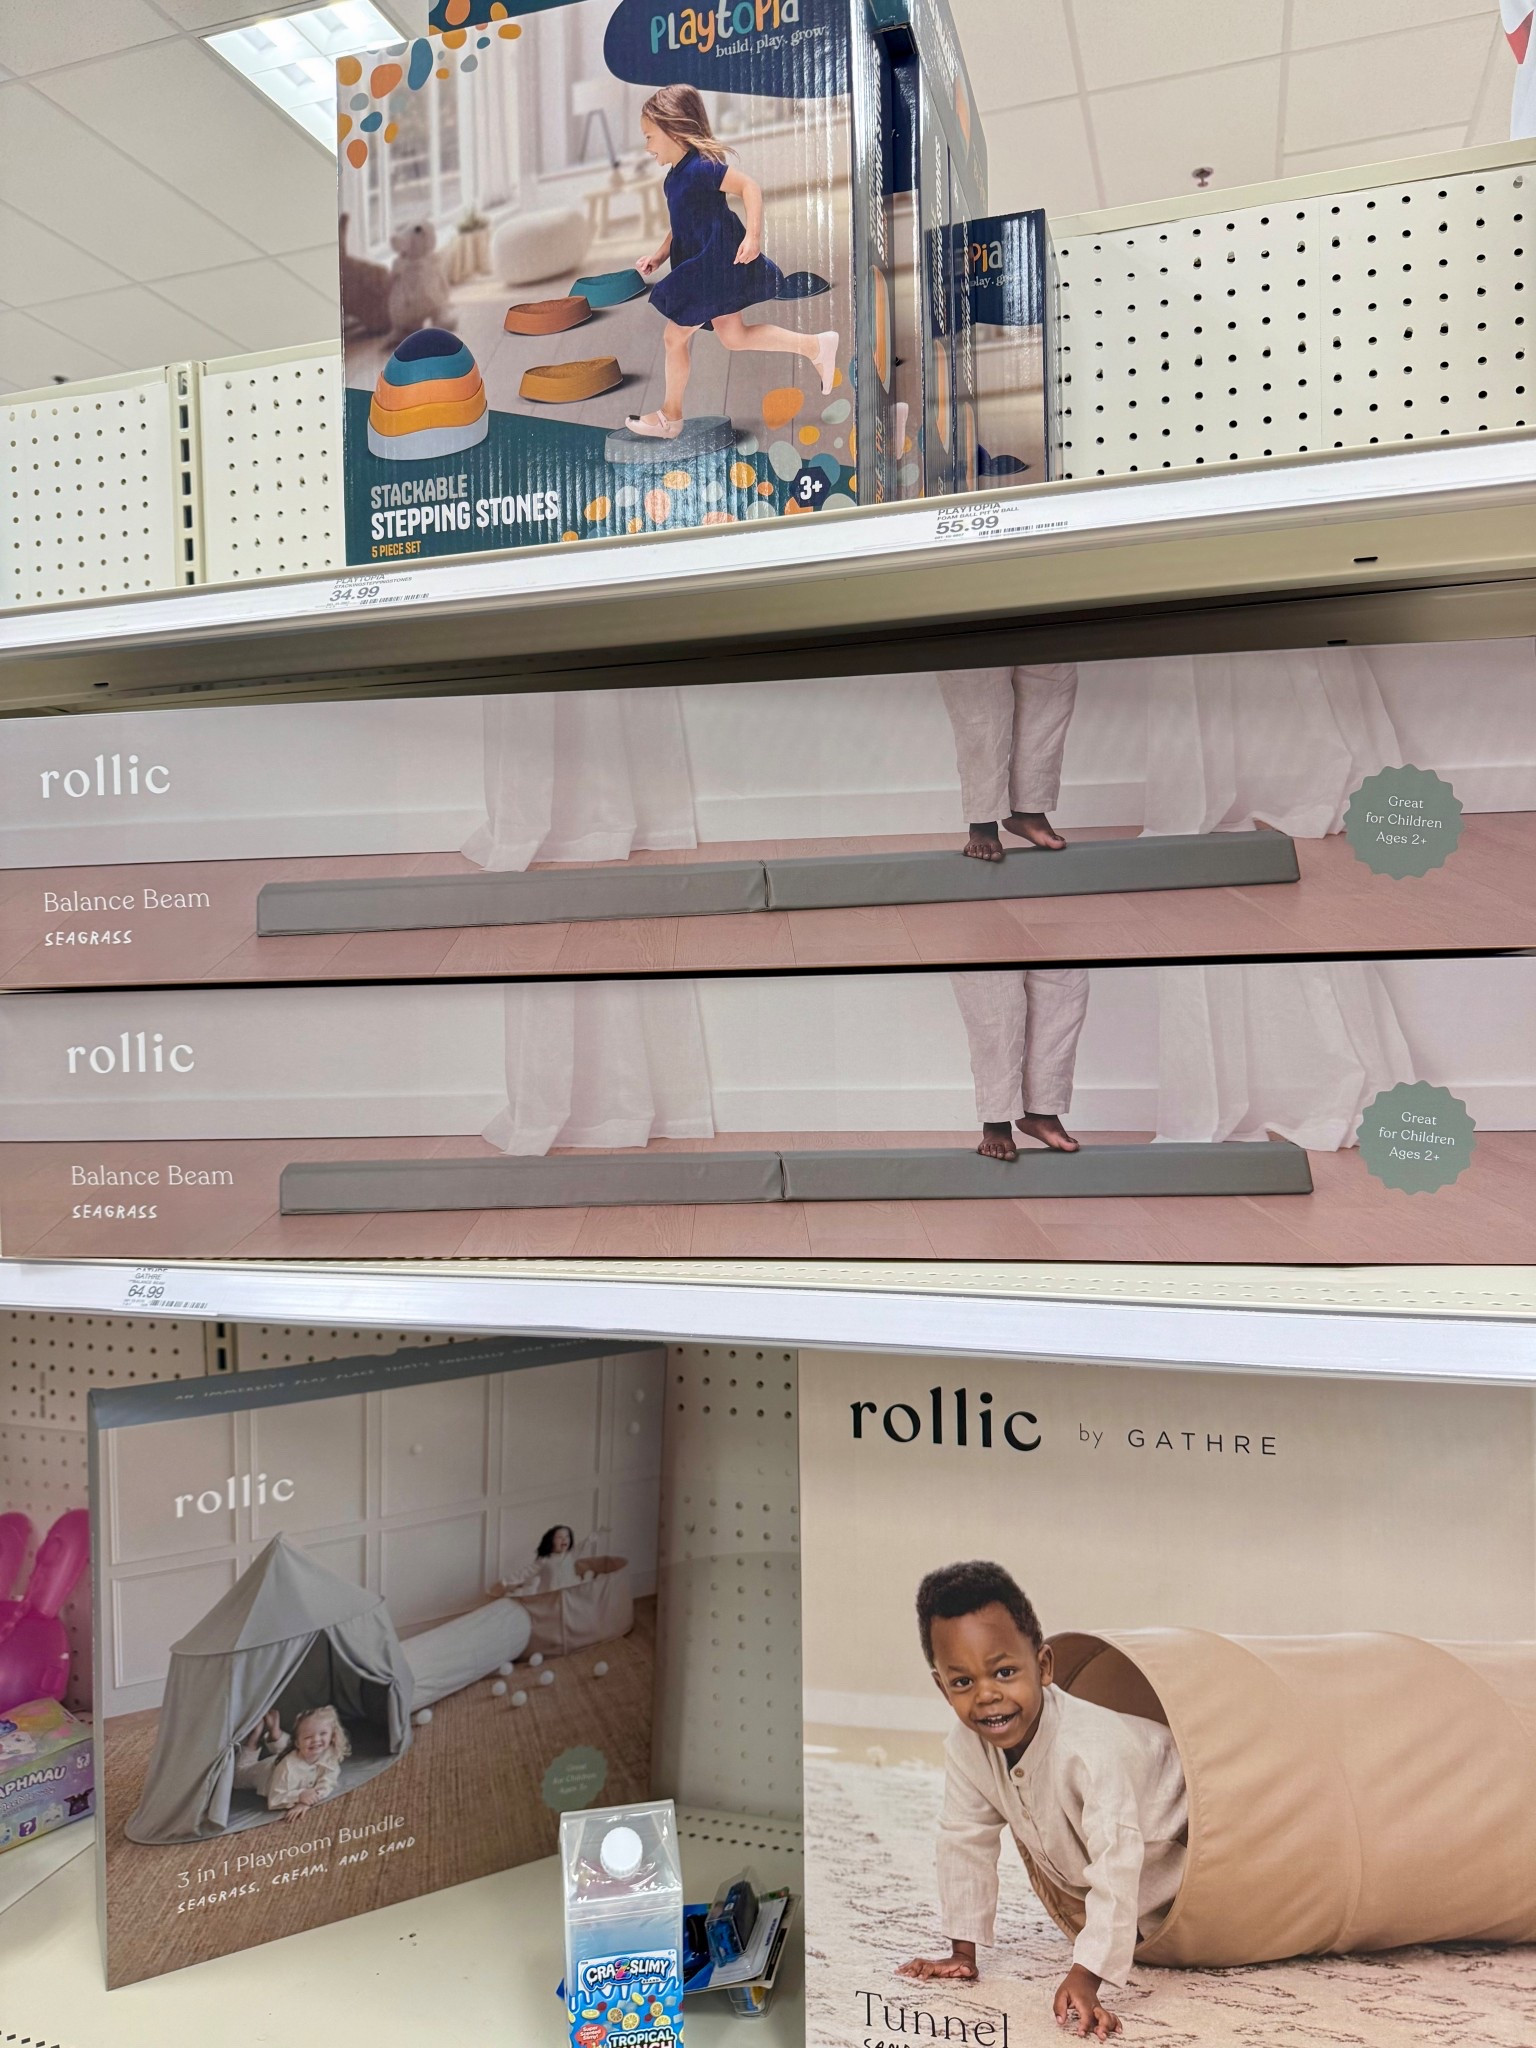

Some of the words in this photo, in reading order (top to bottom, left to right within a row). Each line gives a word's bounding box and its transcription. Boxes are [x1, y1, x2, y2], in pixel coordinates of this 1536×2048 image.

[371, 474, 468, 510] STACKABLE
[800, 475, 823, 500] 3+
[371, 501, 470, 540] STEPPING
[476, 490, 558, 528] STONES
[938, 502, 1001, 516] PLAYTOPIA
[936, 515, 999, 535] 55.99
[371, 545, 378, 558] 5
[379, 543, 404, 557] PIECE
[405, 540, 421, 555] SET
[329, 586, 380, 602] 34.99
[40, 753, 171, 798] rollic
[1388, 795, 1424, 808] Great
[1366, 811, 1384, 823] for
[1387, 813, 1442, 829] Children
[1376, 831, 1408, 845] Ages
[1411, 834, 1427, 845] 2+
[44, 890, 135, 913] Balance
[143, 888, 211, 910] Beam
[44, 930, 133, 946] SEAGRASS
[67, 1031, 195, 1074] rollic
[1401, 1111, 1437, 1126] Great
[1378, 1126, 1398, 1139] for
[1400, 1129, 1455, 1146] Children
[1388, 1146, 1421, 1160] Ages
[1424, 1149, 1440, 1161] 2+
[71, 1164, 160, 1186] Balance
[168, 1164, 234, 1185] Beam
[72, 1204, 158, 1219] SEAGRASS
[128, 1284, 165, 1299] 64.99
[850, 1386, 1042, 1452] rollic
[1079, 1423, 1104, 1449] by
[1127, 1428, 1278, 1456] GATHRE
[174, 1472, 295, 1519] rollic
[177, 1871, 189, 1888] 3
[197, 1867, 216, 1884] in
[236, 1835, 332, 1873] Playroom
[339, 1814, 405, 1844] Bundle
[338, 1851, 369, 1867] AND
[377, 1836, 416, 1856] SAND
[855, 1990, 1008, 2048] Tunnel
[610, 2029, 674, 2048] TROPICAL
